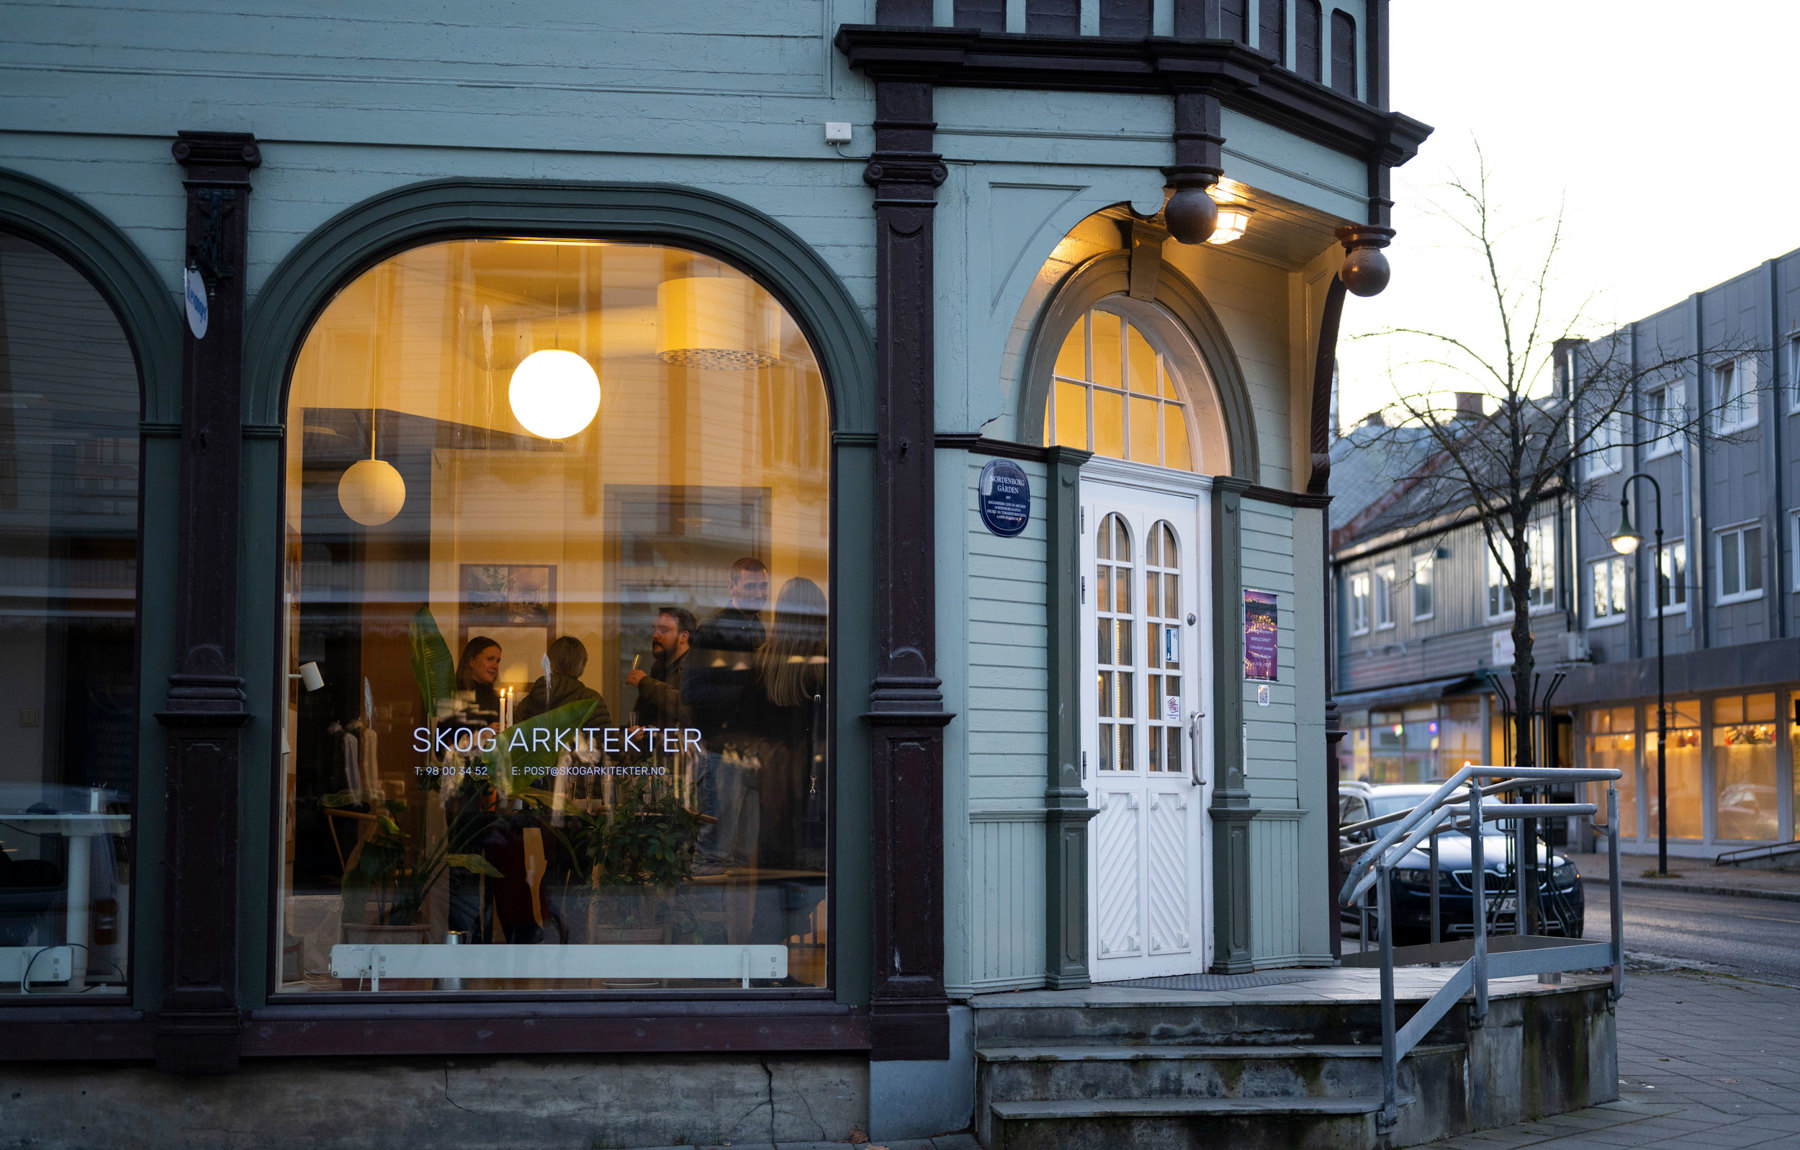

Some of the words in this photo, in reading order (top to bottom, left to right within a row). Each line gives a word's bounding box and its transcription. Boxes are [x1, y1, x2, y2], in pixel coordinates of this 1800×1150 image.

[412, 727, 497, 753] SKOG
[507, 727, 702, 753] ARKITEKTER
[414, 766, 423, 776] T:
[426, 766, 439, 776] 98
[442, 766, 456, 776] 00
[460, 766, 472, 776] 34
[475, 766, 488, 776] 52
[511, 766, 521, 776] E:
[524, 766, 666, 776] POST@SKOGARKITEKTER.NO
